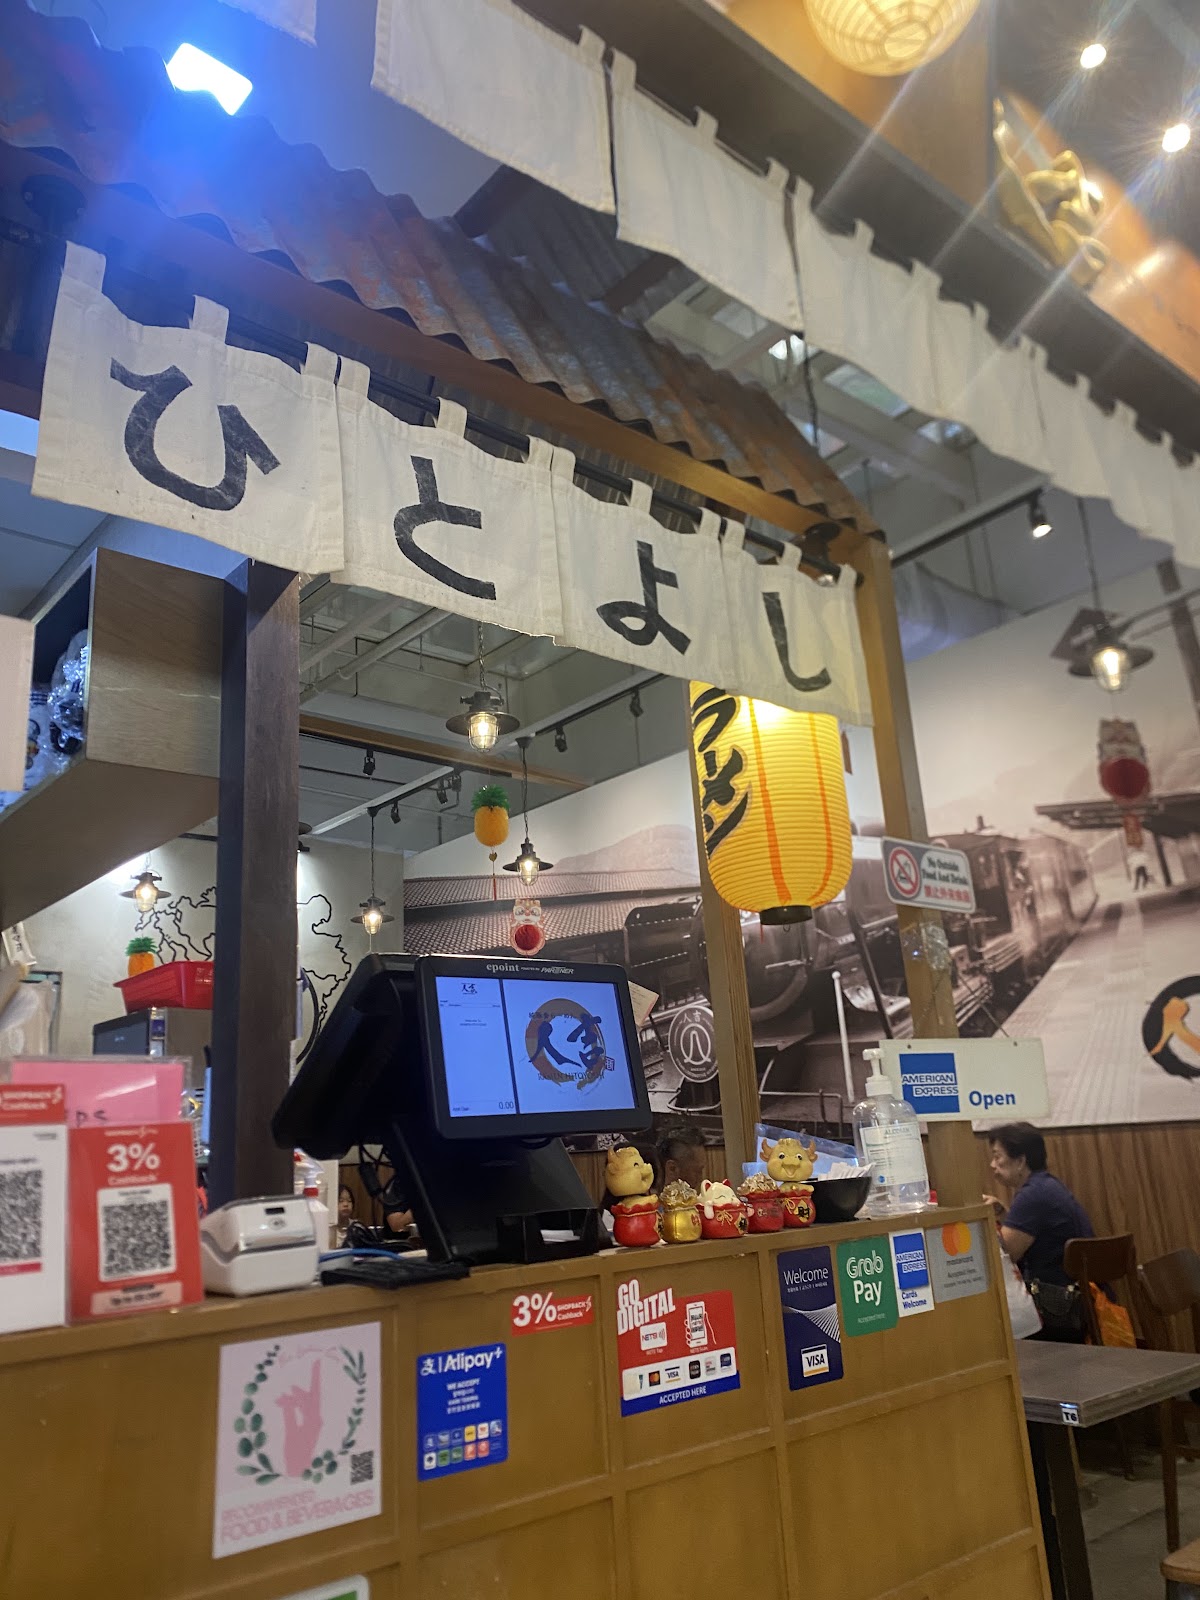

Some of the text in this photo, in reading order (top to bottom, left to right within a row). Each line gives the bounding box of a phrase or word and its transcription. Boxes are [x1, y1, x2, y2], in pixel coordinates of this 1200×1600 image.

[486, 963, 520, 973] epoint
[902, 1074, 955, 1083] AMERICAN
[914, 1087, 959, 1096] EXPRESS
[969, 1091, 1016, 1109] Open
[107, 1143, 160, 1172] 3%
[846, 1250, 884, 1278] Grab
[896, 1251, 923, 1262] AMERICAN
[903, 1261, 927, 1272] EXPRESS
[783, 1268, 829, 1285] Welcome
[618, 1279, 640, 1308] GO
[853, 1280, 882, 1306] Pay
[901, 1291, 917, 1300] Cards
[513, 1292, 557, 1327] 3%
[616, 1288, 676, 1335] DIGITAL
[902, 1299, 927, 1309] Welcome
[805, 1353, 826, 1367] VISA
[659, 1386, 707, 1405] ACCEPTED HERE
